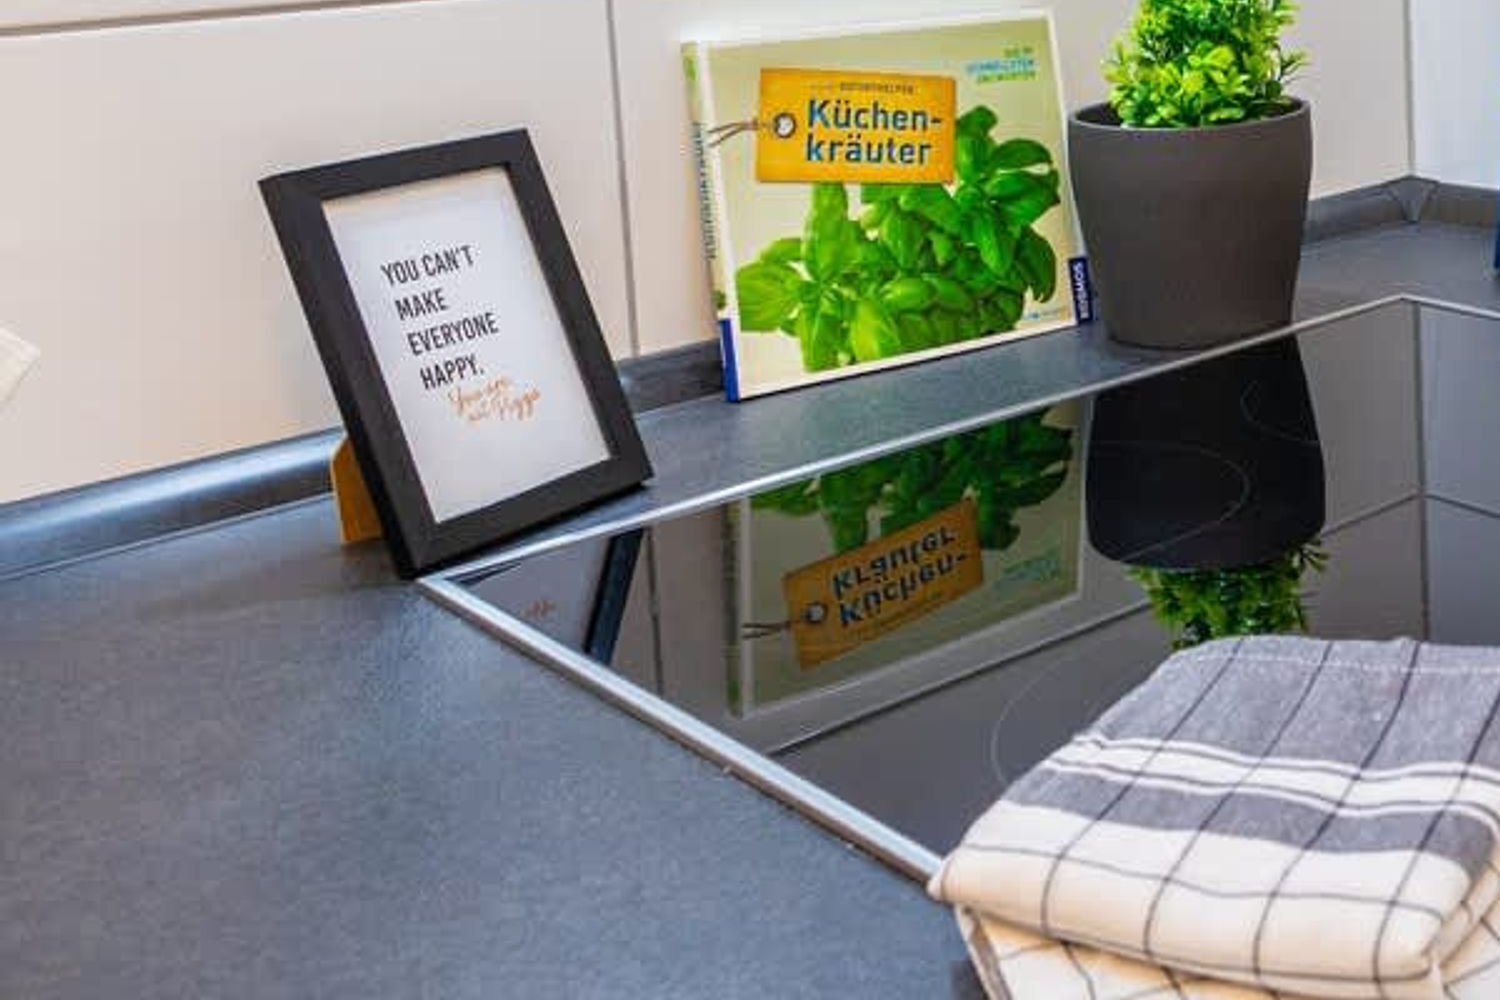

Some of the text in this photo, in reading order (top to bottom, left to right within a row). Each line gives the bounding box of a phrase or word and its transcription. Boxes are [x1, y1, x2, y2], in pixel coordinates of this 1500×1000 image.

[808, 98, 942, 131] Küchen-
[806, 133, 932, 165] kräuter
[380, 245, 474, 286] YOU CAN'T
[395, 288, 448, 321] MAKE
[407, 312, 499, 356] EVERYONE
[420, 354, 484, 390] HAPPY.
